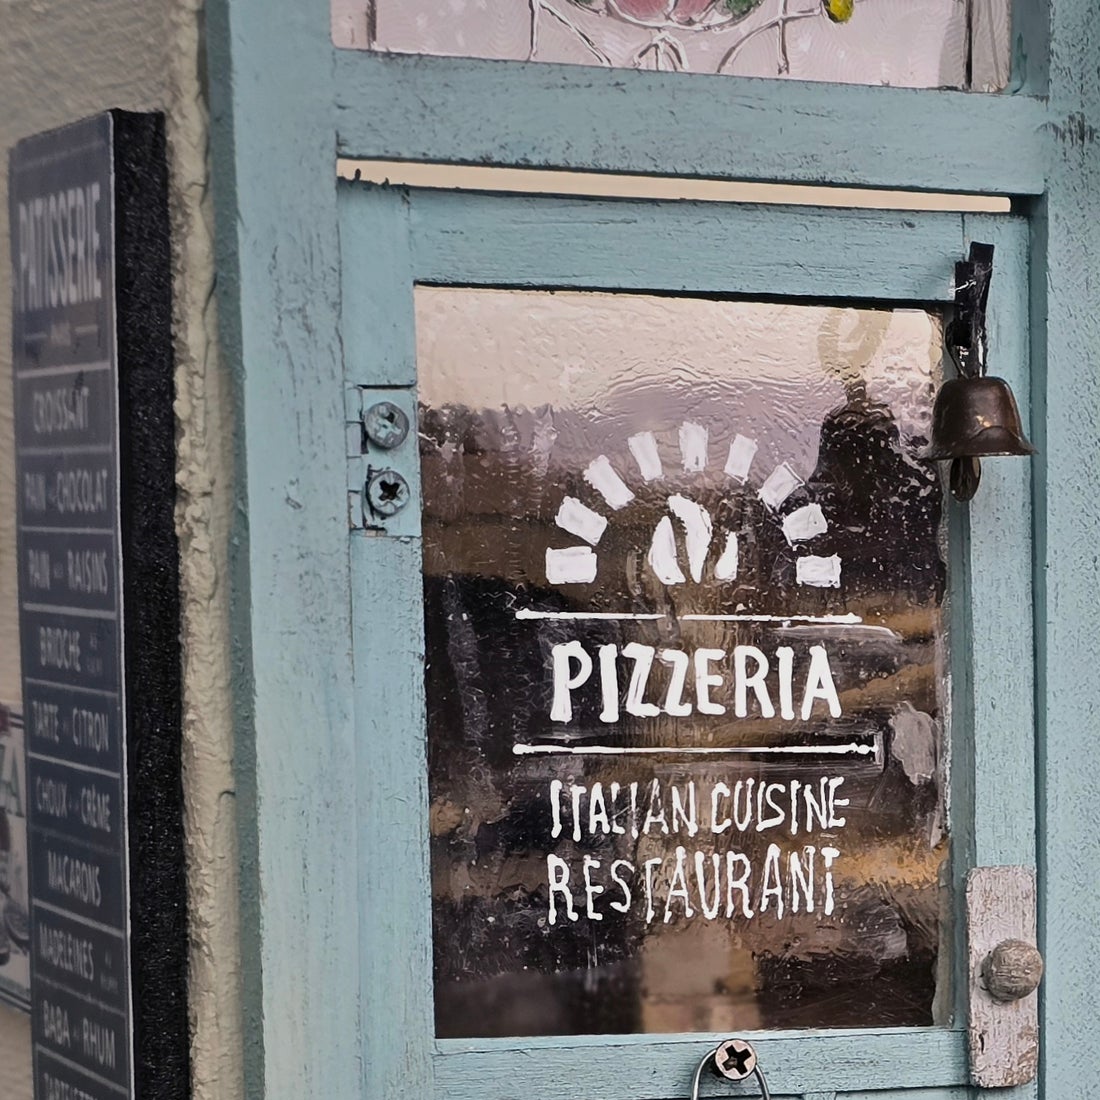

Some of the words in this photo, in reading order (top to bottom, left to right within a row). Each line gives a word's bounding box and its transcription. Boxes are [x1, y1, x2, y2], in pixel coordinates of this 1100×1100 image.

[33, 386, 89, 433] CROISSANT
[57, 469, 108, 514] CHOCOLAT
[67, 549, 108, 595] RAISINS
[40, 626, 81, 673] BRIOCHE
[549, 641, 842, 723] PIZZERIA
[32, 700, 60, 745] TARTE
[72, 706, 109, 753] CITRON
[36, 776, 68, 819] CHOUX
[550, 778, 699, 842] ITALIAN
[711, 776, 850, 835] CUISINE
[48, 849, 102, 908] MACARONS
[547, 843, 841, 925] RESTAURANT
[40, 922, 95, 981] MADELEINES
[43, 1000, 71, 1049] BABA
[82, 1017, 116, 1070] RHUM
